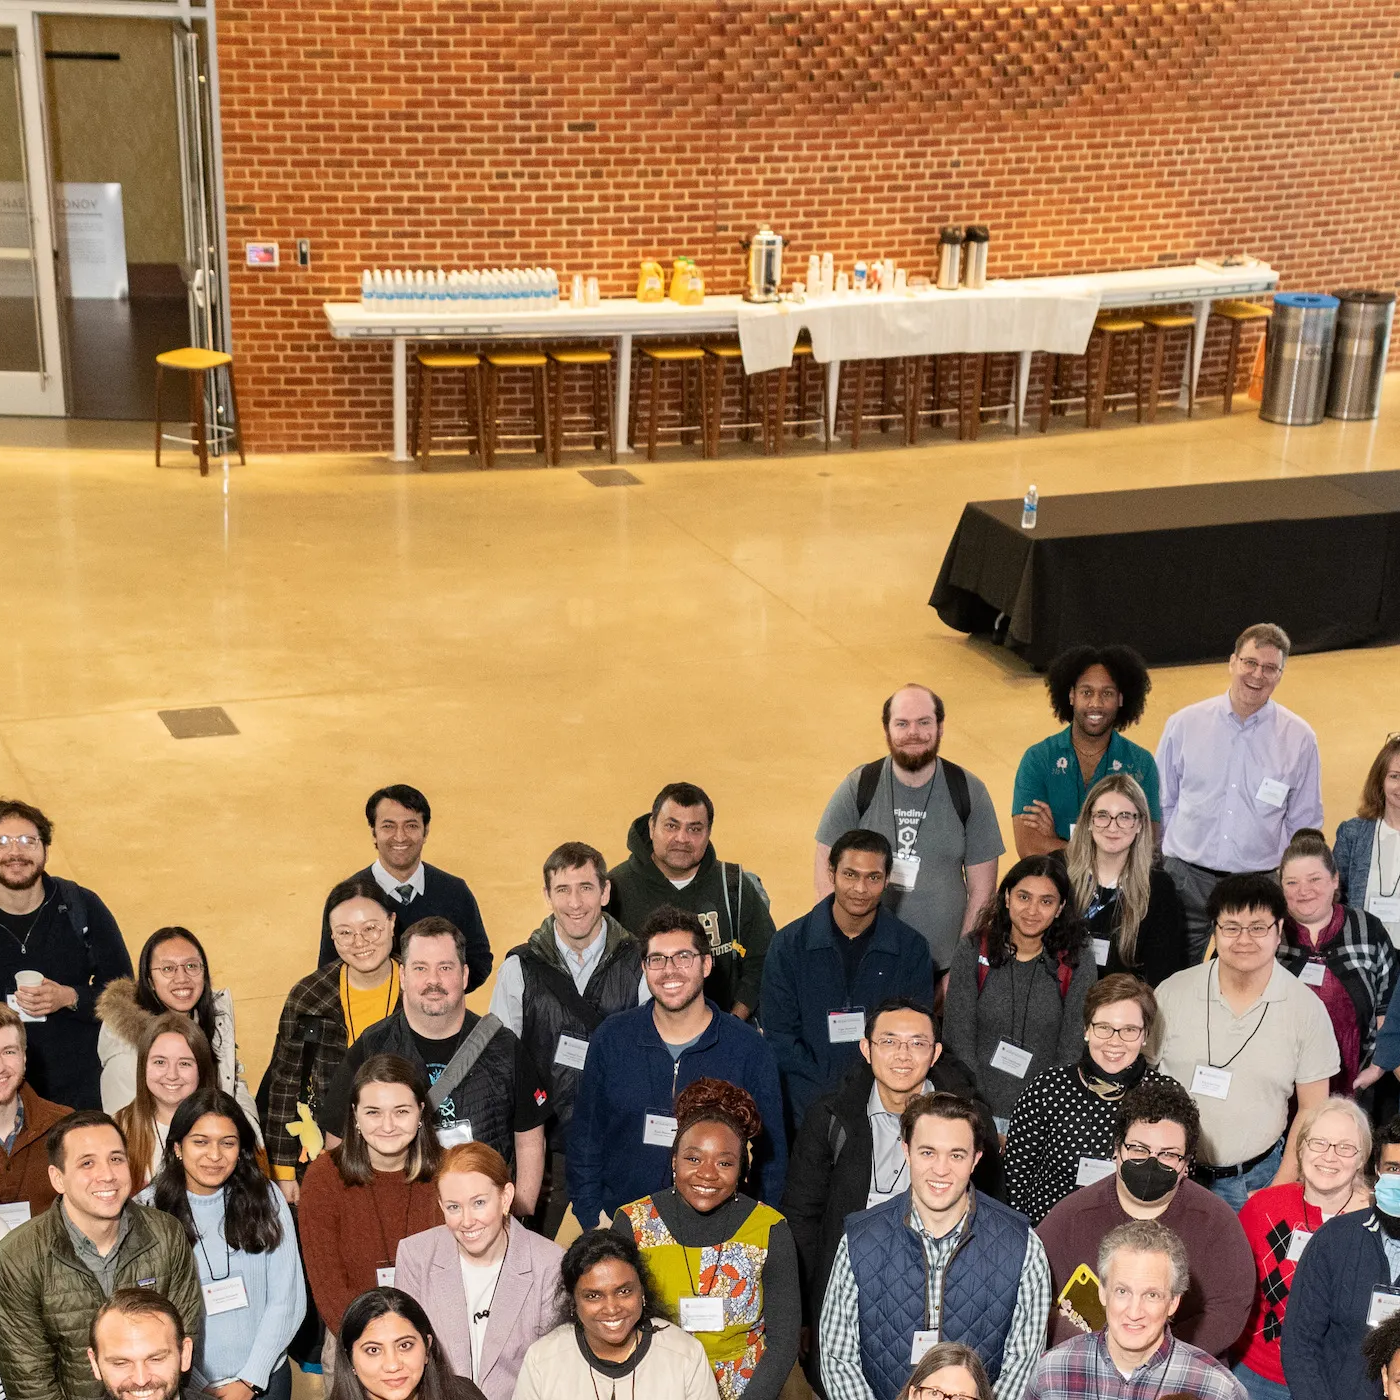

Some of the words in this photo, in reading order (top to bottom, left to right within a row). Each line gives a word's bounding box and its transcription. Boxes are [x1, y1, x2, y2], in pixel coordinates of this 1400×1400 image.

[894, 808, 927, 819] Finding
[898, 817, 920, 825] your
[711, 942, 733, 956] TUTES
